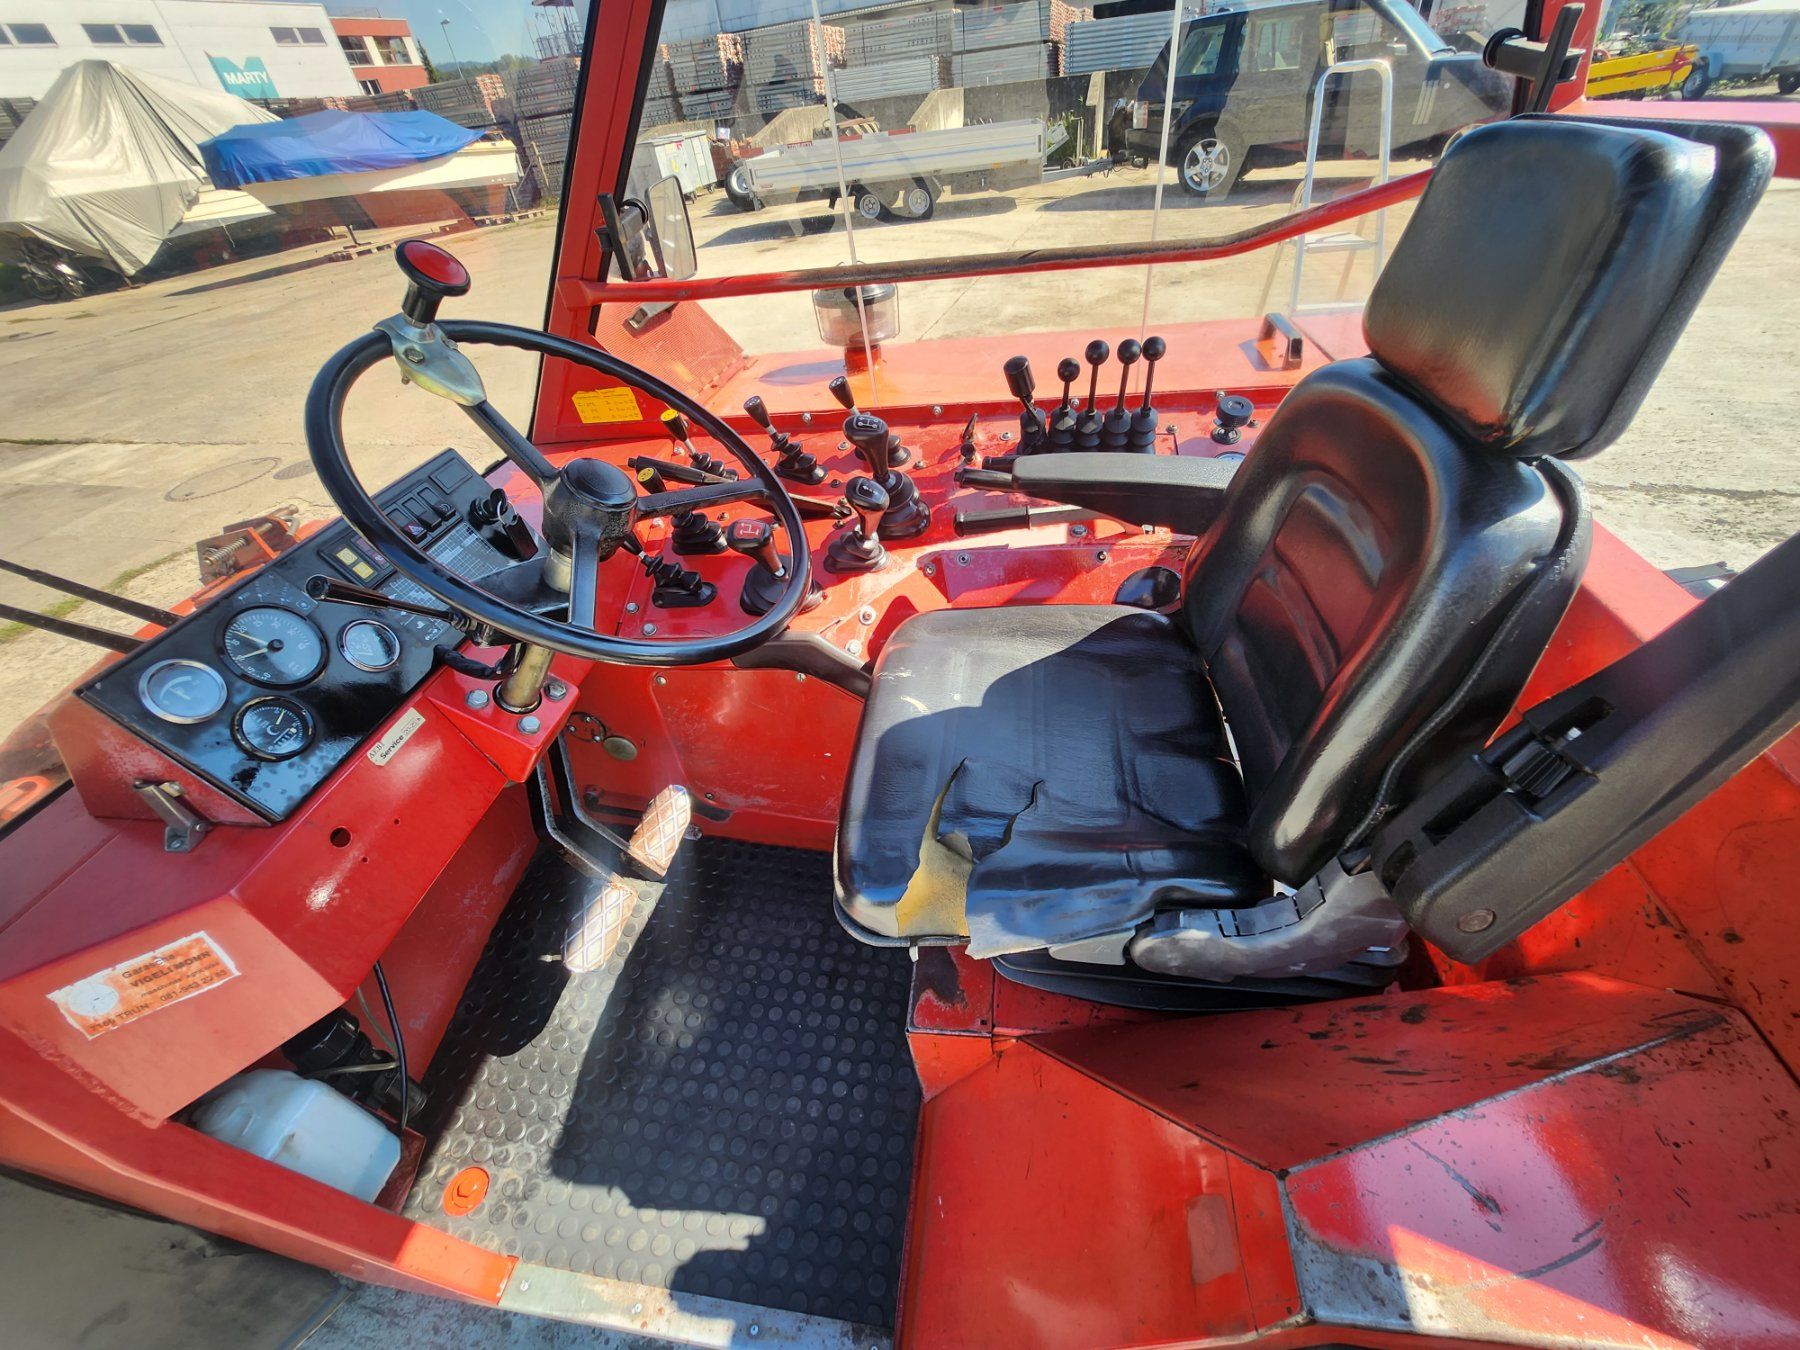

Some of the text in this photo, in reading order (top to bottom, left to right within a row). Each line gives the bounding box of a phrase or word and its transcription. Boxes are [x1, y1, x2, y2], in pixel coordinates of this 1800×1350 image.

[223, 71, 269, 85] MARTY
[380, 735, 404, 760] Service
[130, 967, 174, 988] VIGELI
[115, 1003, 150, 1021] TRUN
